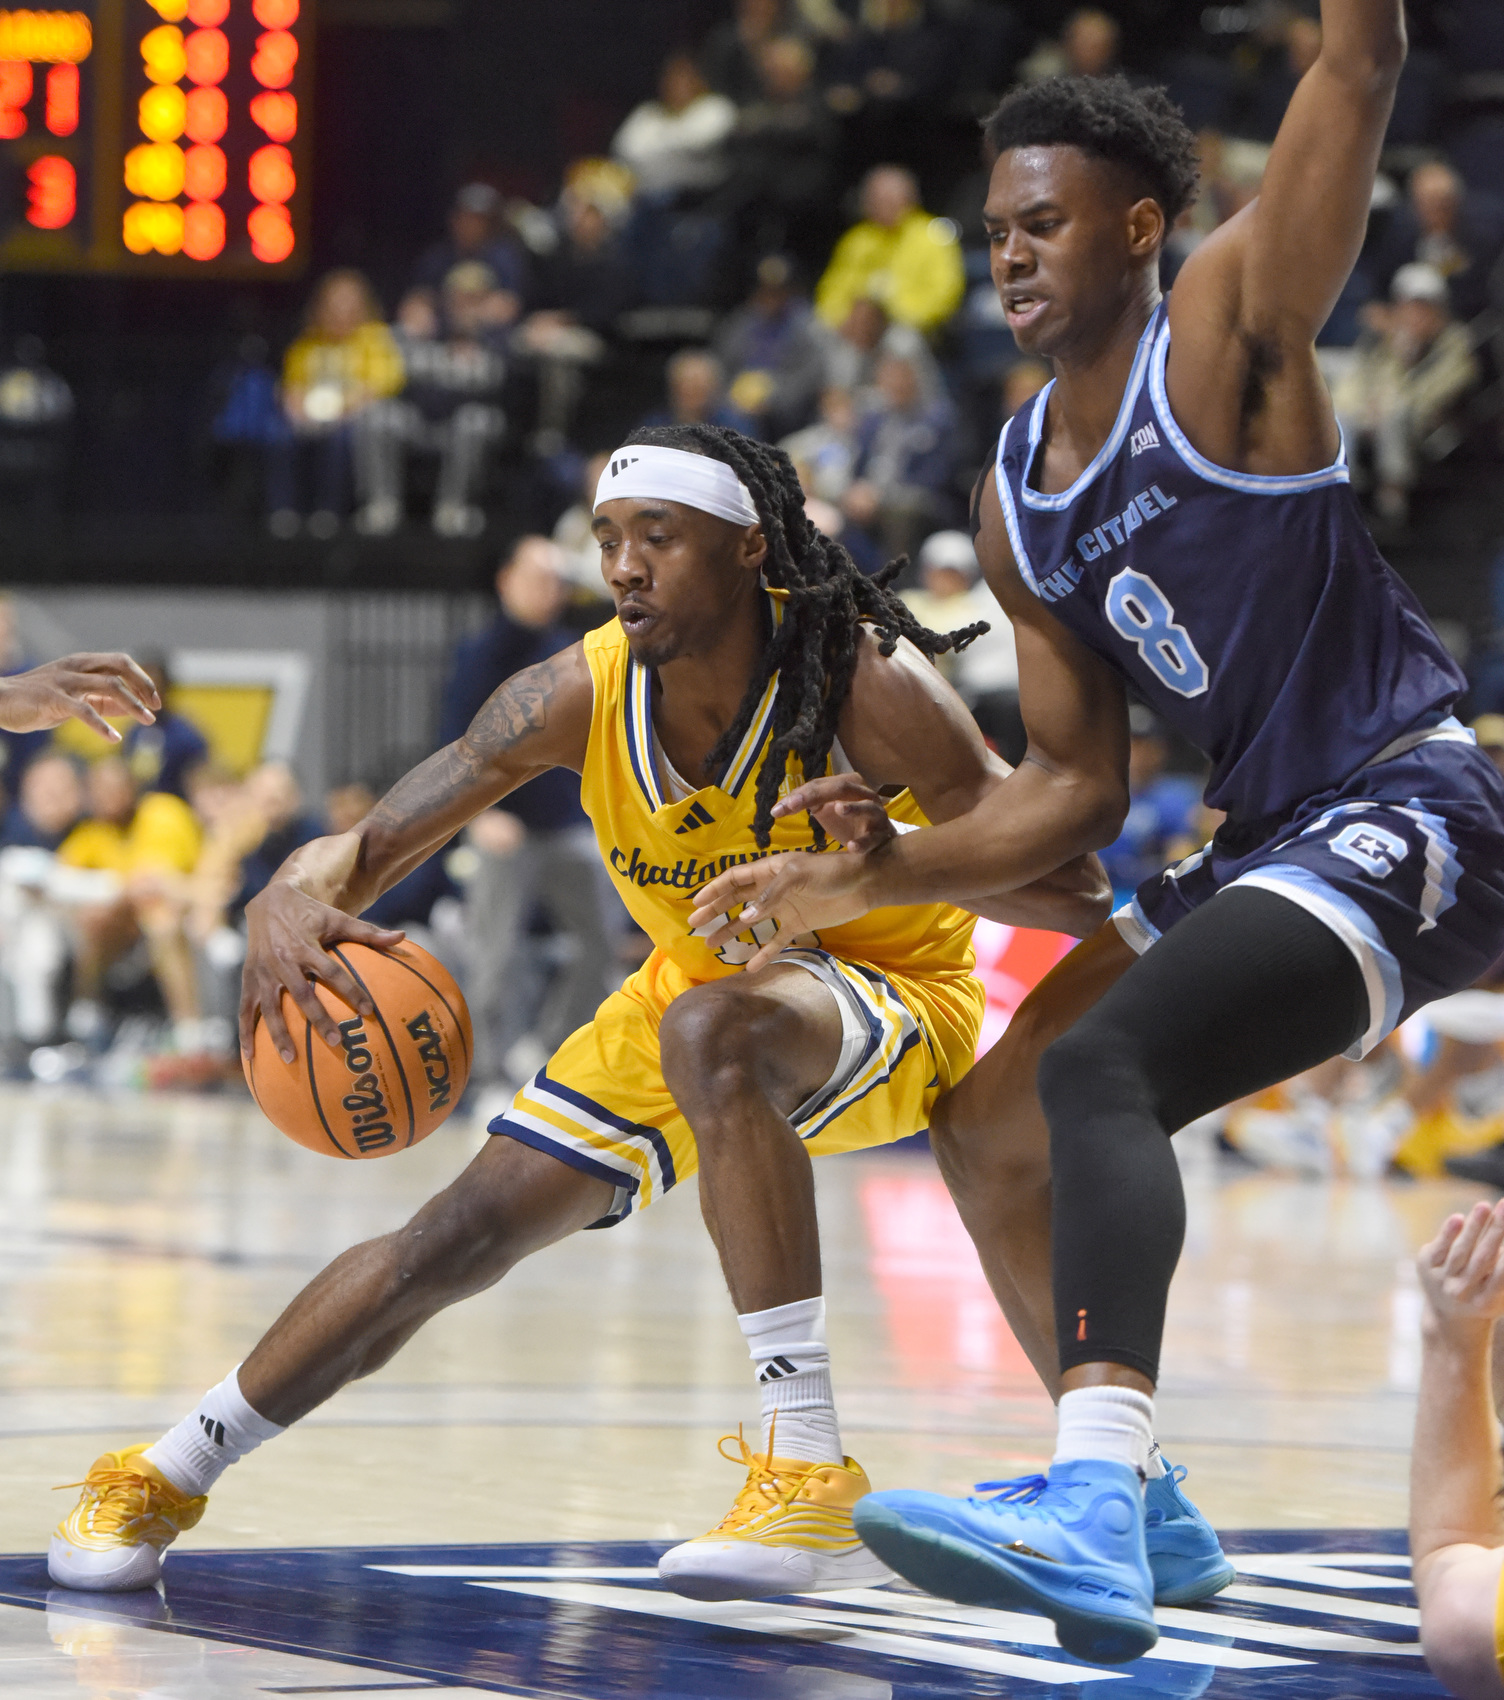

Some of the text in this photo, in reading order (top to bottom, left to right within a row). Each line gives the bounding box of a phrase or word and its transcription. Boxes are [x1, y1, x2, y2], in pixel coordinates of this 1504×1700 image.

[1105, 566, 1209, 699] 8
[337, 1014, 397, 1153] Wilson
[406, 1010, 451, 1113] NCAA
